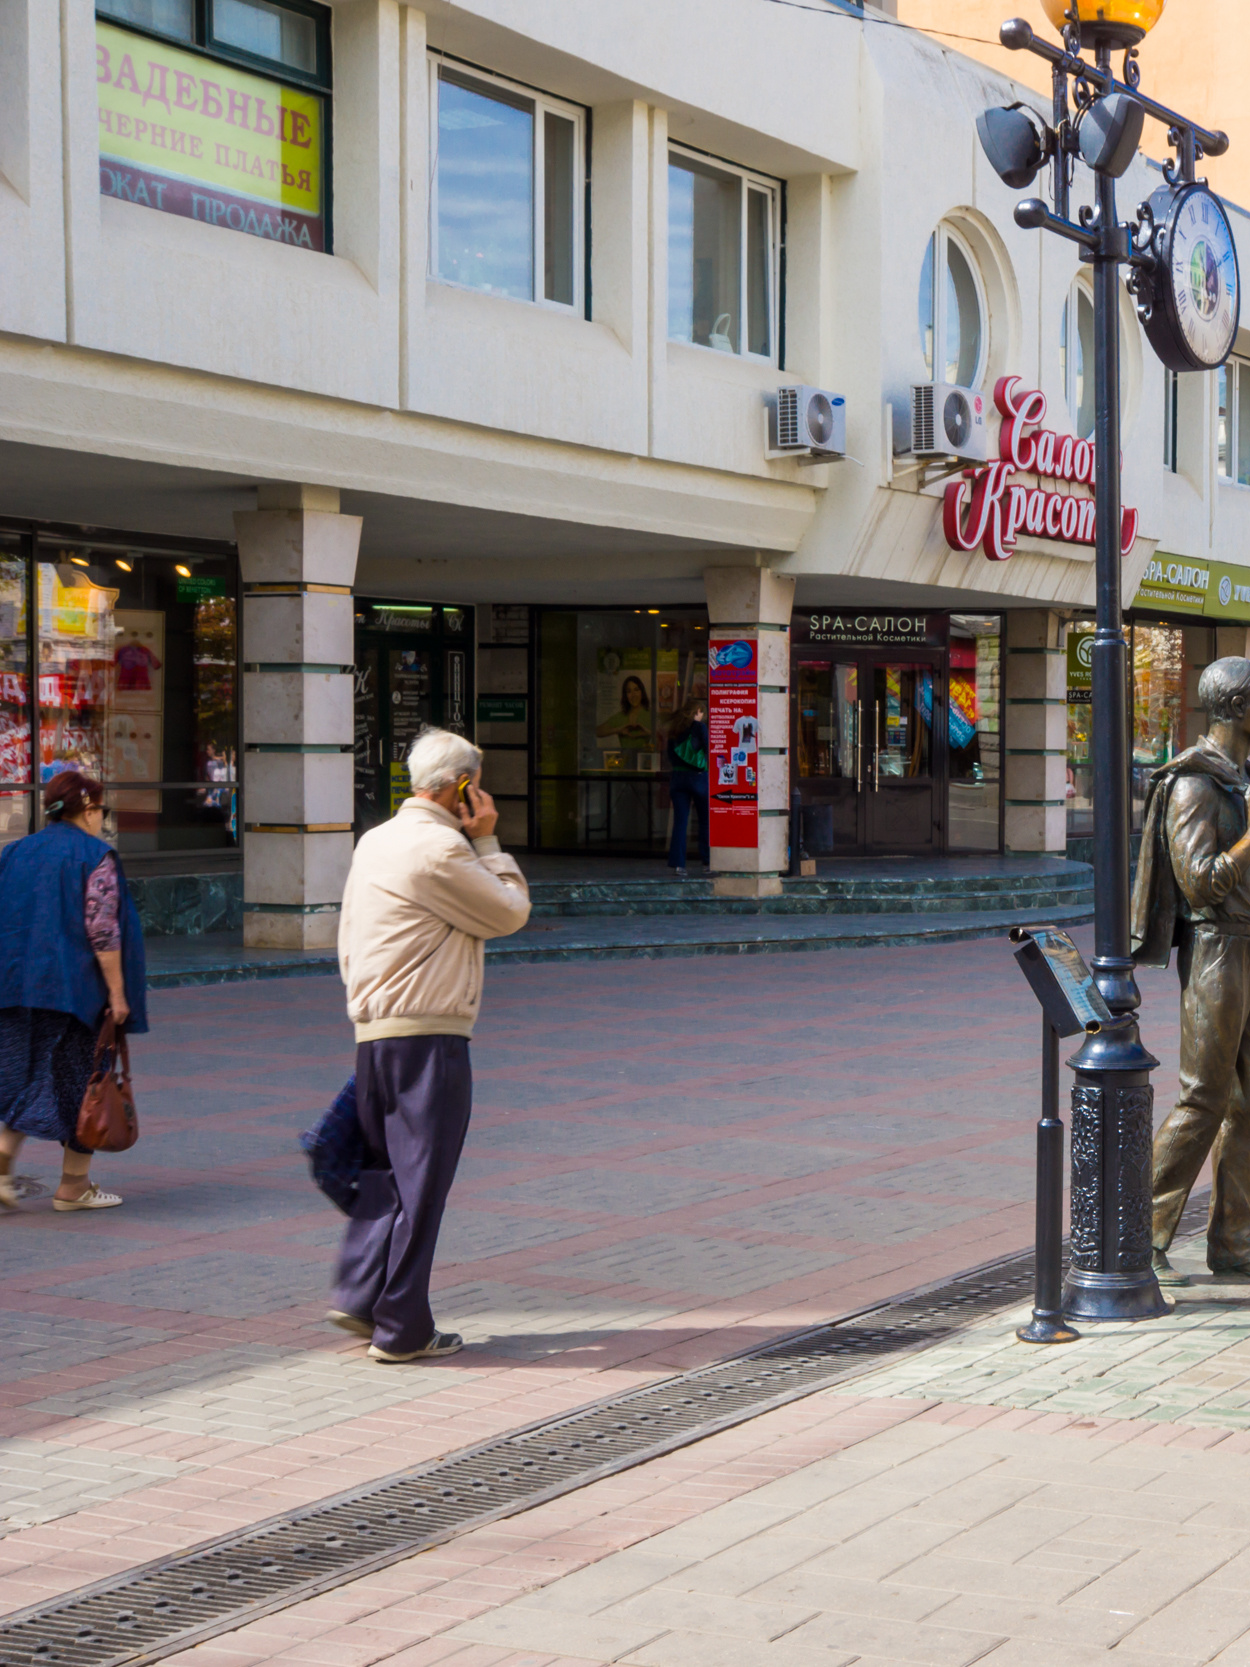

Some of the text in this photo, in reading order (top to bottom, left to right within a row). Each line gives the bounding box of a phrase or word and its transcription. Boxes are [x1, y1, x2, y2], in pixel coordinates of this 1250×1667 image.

[214, 142, 313, 193] ПЛАТЬЯ
[191, 193, 314, 249] ПРОДАЖА
[994, 376, 1122, 485] Сало
[1176, 592, 1204, 605] Косметики
[809, 614, 927, 633] SPA-САЛОН
[809, 631, 927, 643] Растительной Косметики
